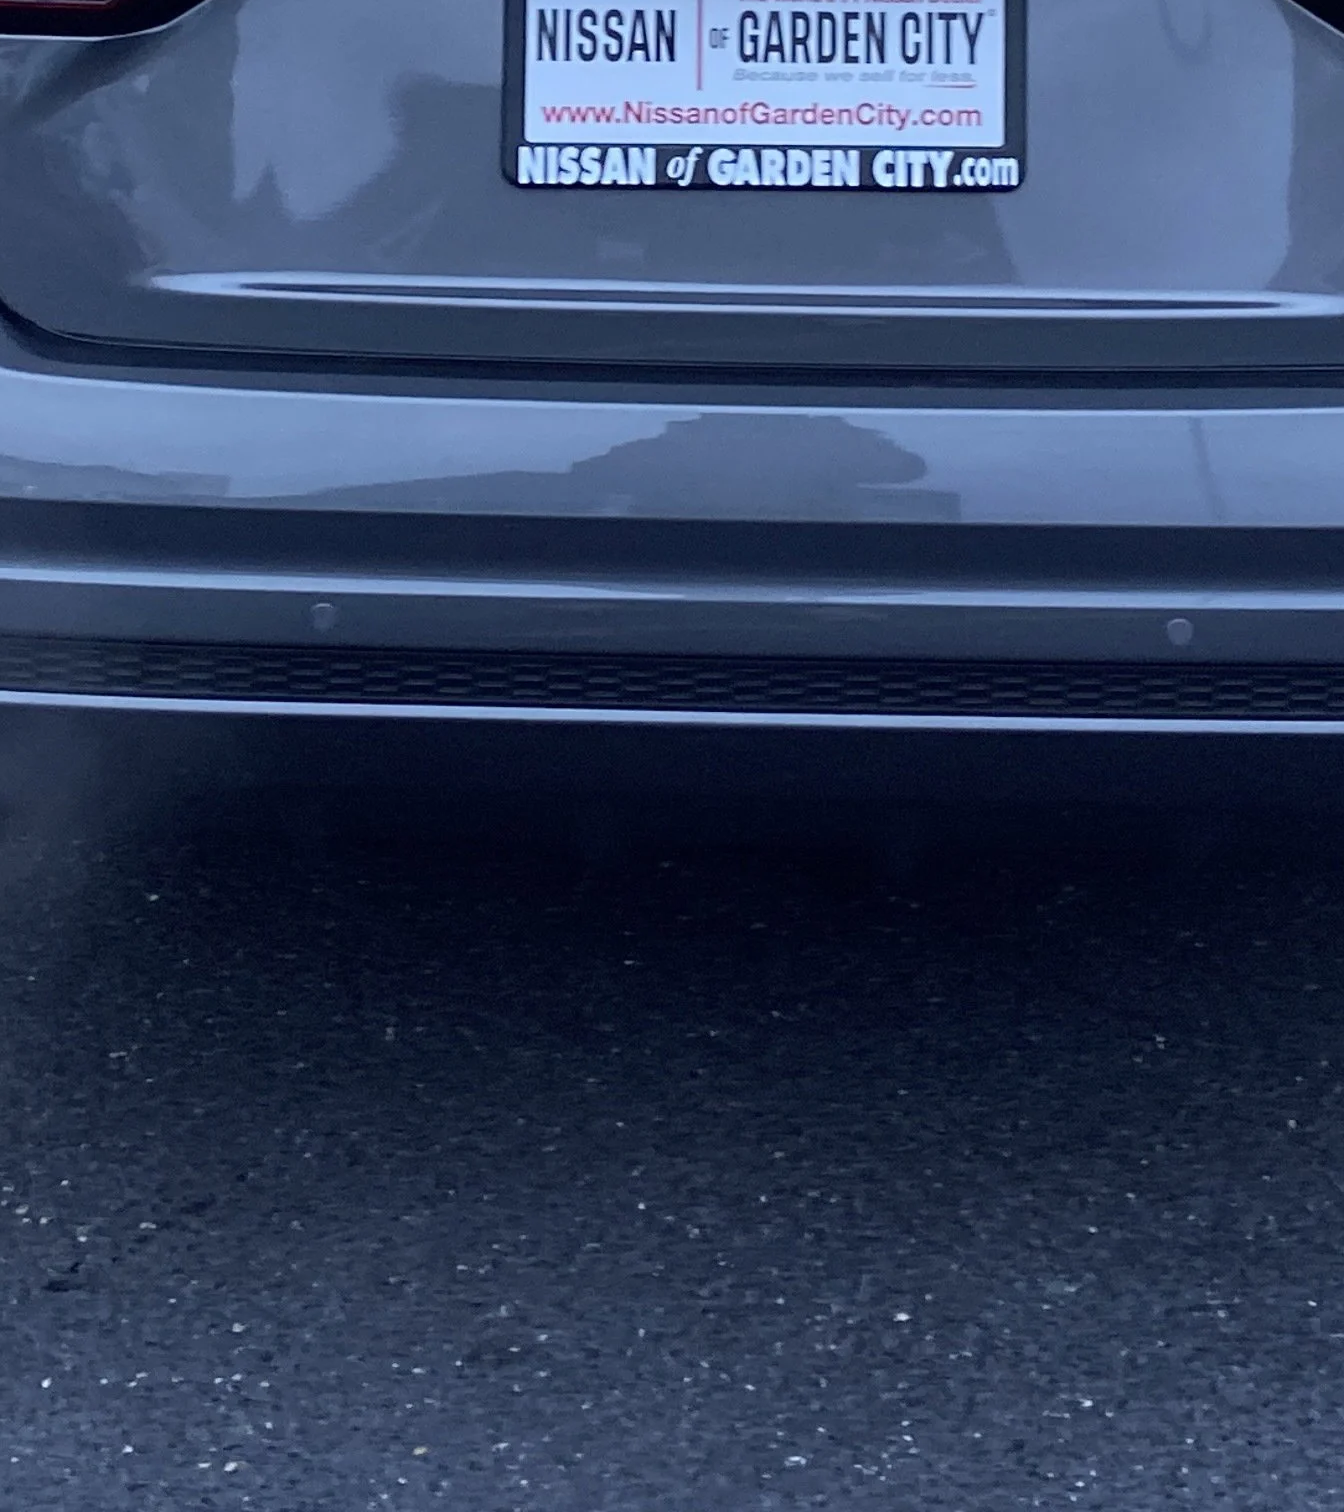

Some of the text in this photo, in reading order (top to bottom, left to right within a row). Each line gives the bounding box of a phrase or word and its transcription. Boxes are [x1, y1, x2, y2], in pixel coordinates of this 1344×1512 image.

[536, 8, 984, 65] NISSAN OF GARDEN CITY
[732, 67, 820, 82] Because
[823, 70, 855, 83] we
[858, 69, 897, 83] sell
[898, 69, 927, 83] for
[540, 100, 983, 131] www.NissanofGardenCity.com
[517, 145, 1020, 188] NISSAN of GARDEN CITY.com
